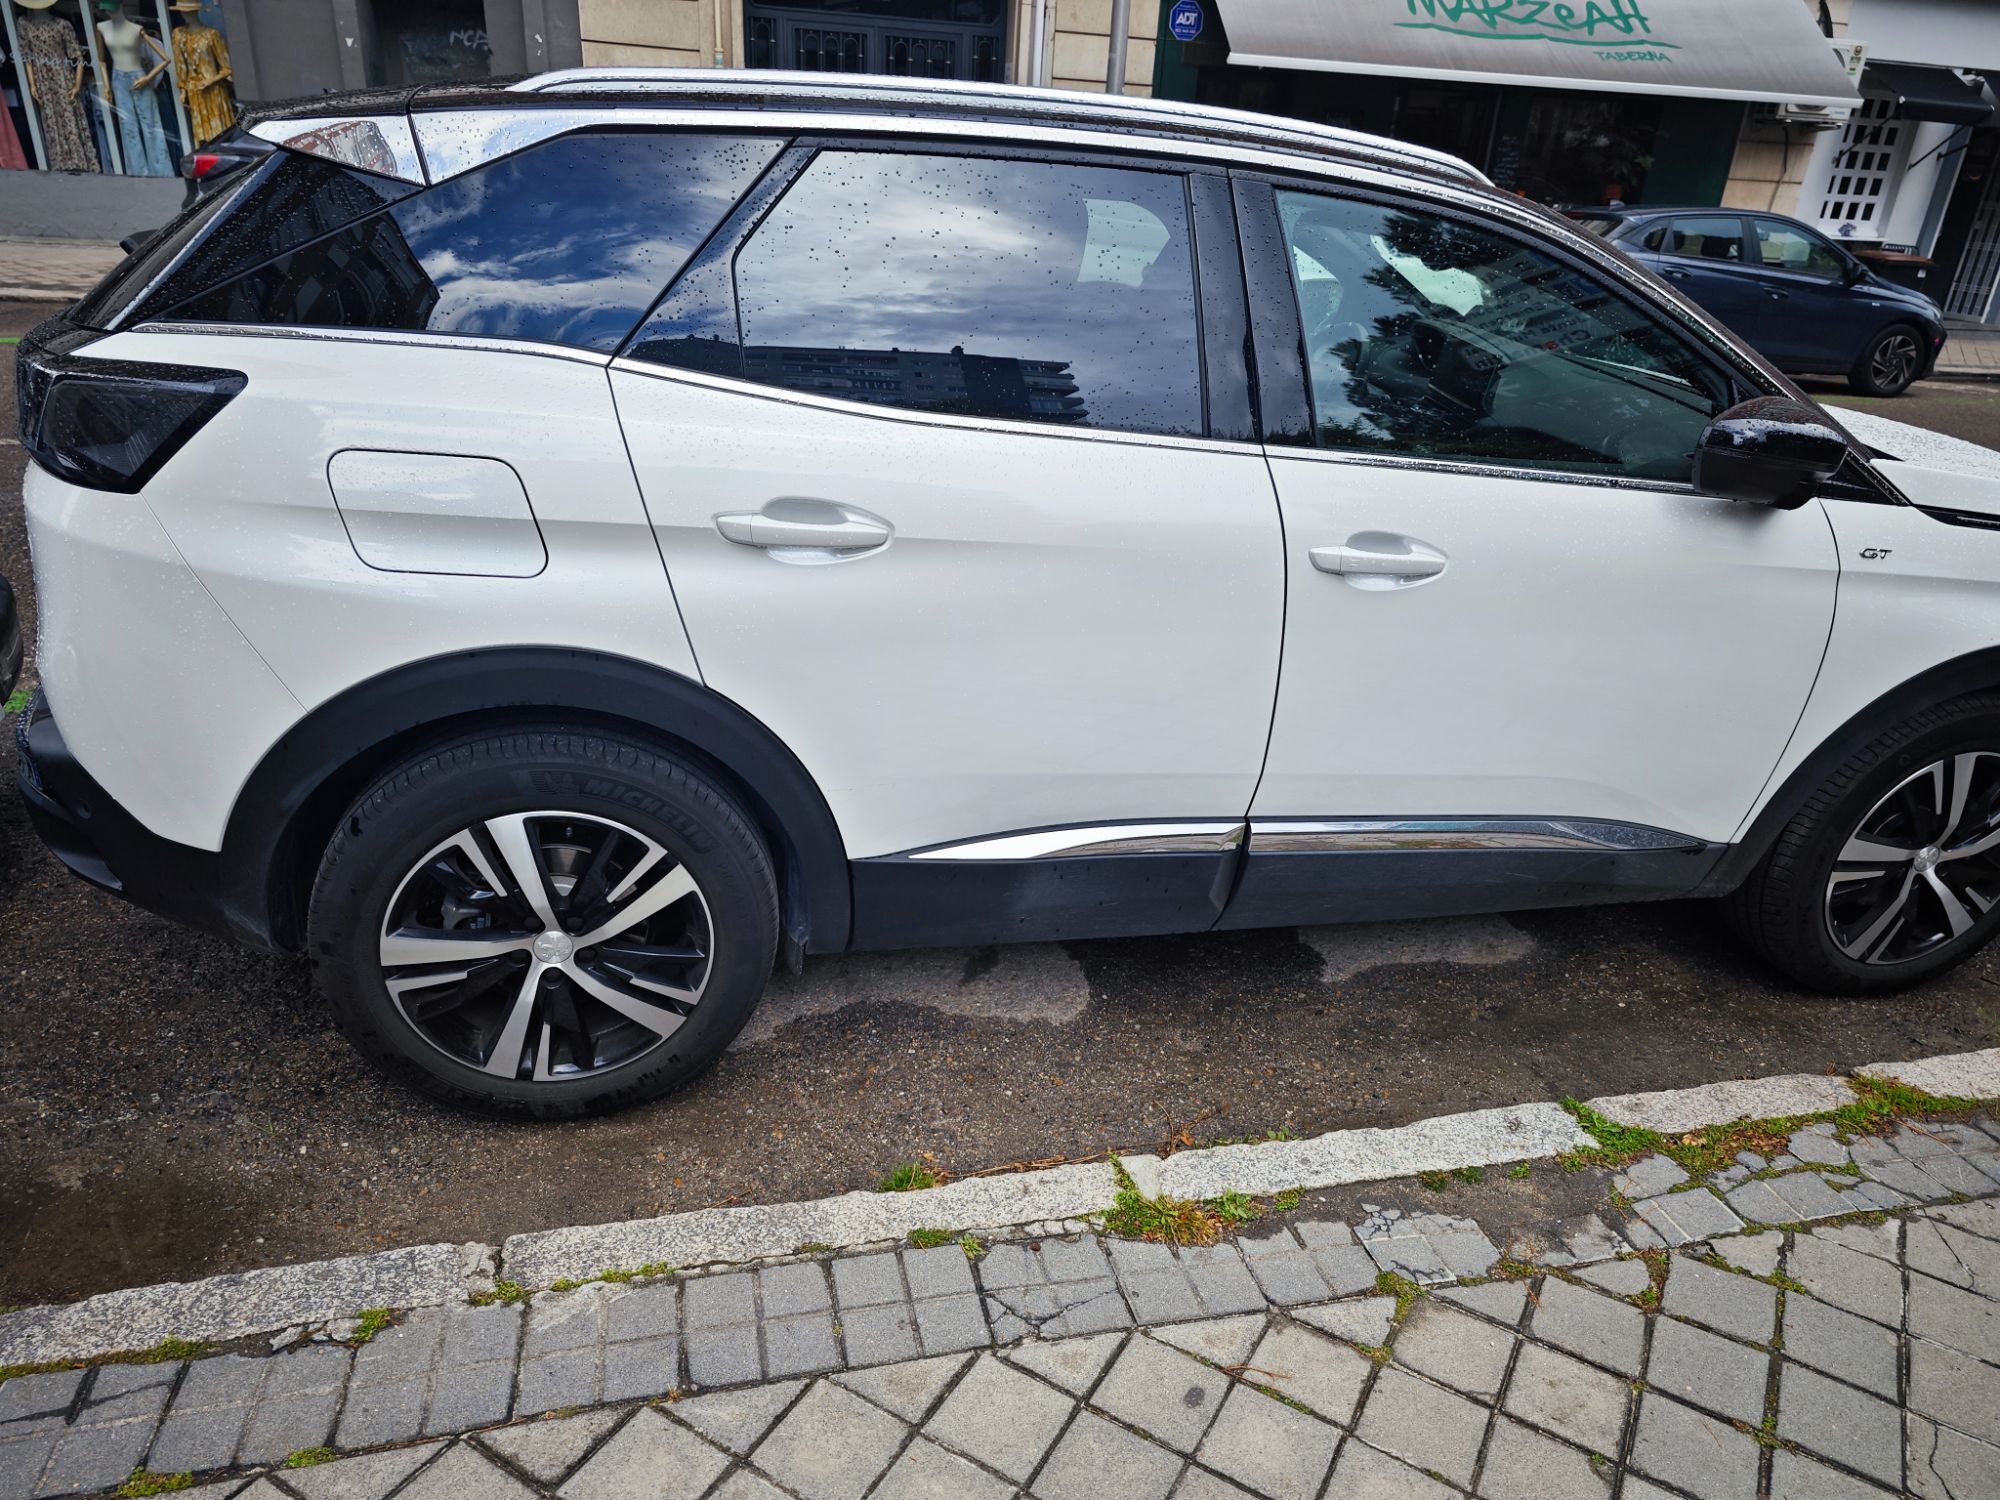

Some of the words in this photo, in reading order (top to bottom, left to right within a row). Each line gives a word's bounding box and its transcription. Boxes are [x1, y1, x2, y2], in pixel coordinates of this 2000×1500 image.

[1175, 12, 1198, 26] ADT
[1593, 50, 1672, 63] TABERNA
[1859, 548, 1892, 560] GT
[583, 778, 718, 854] MICHELIN
